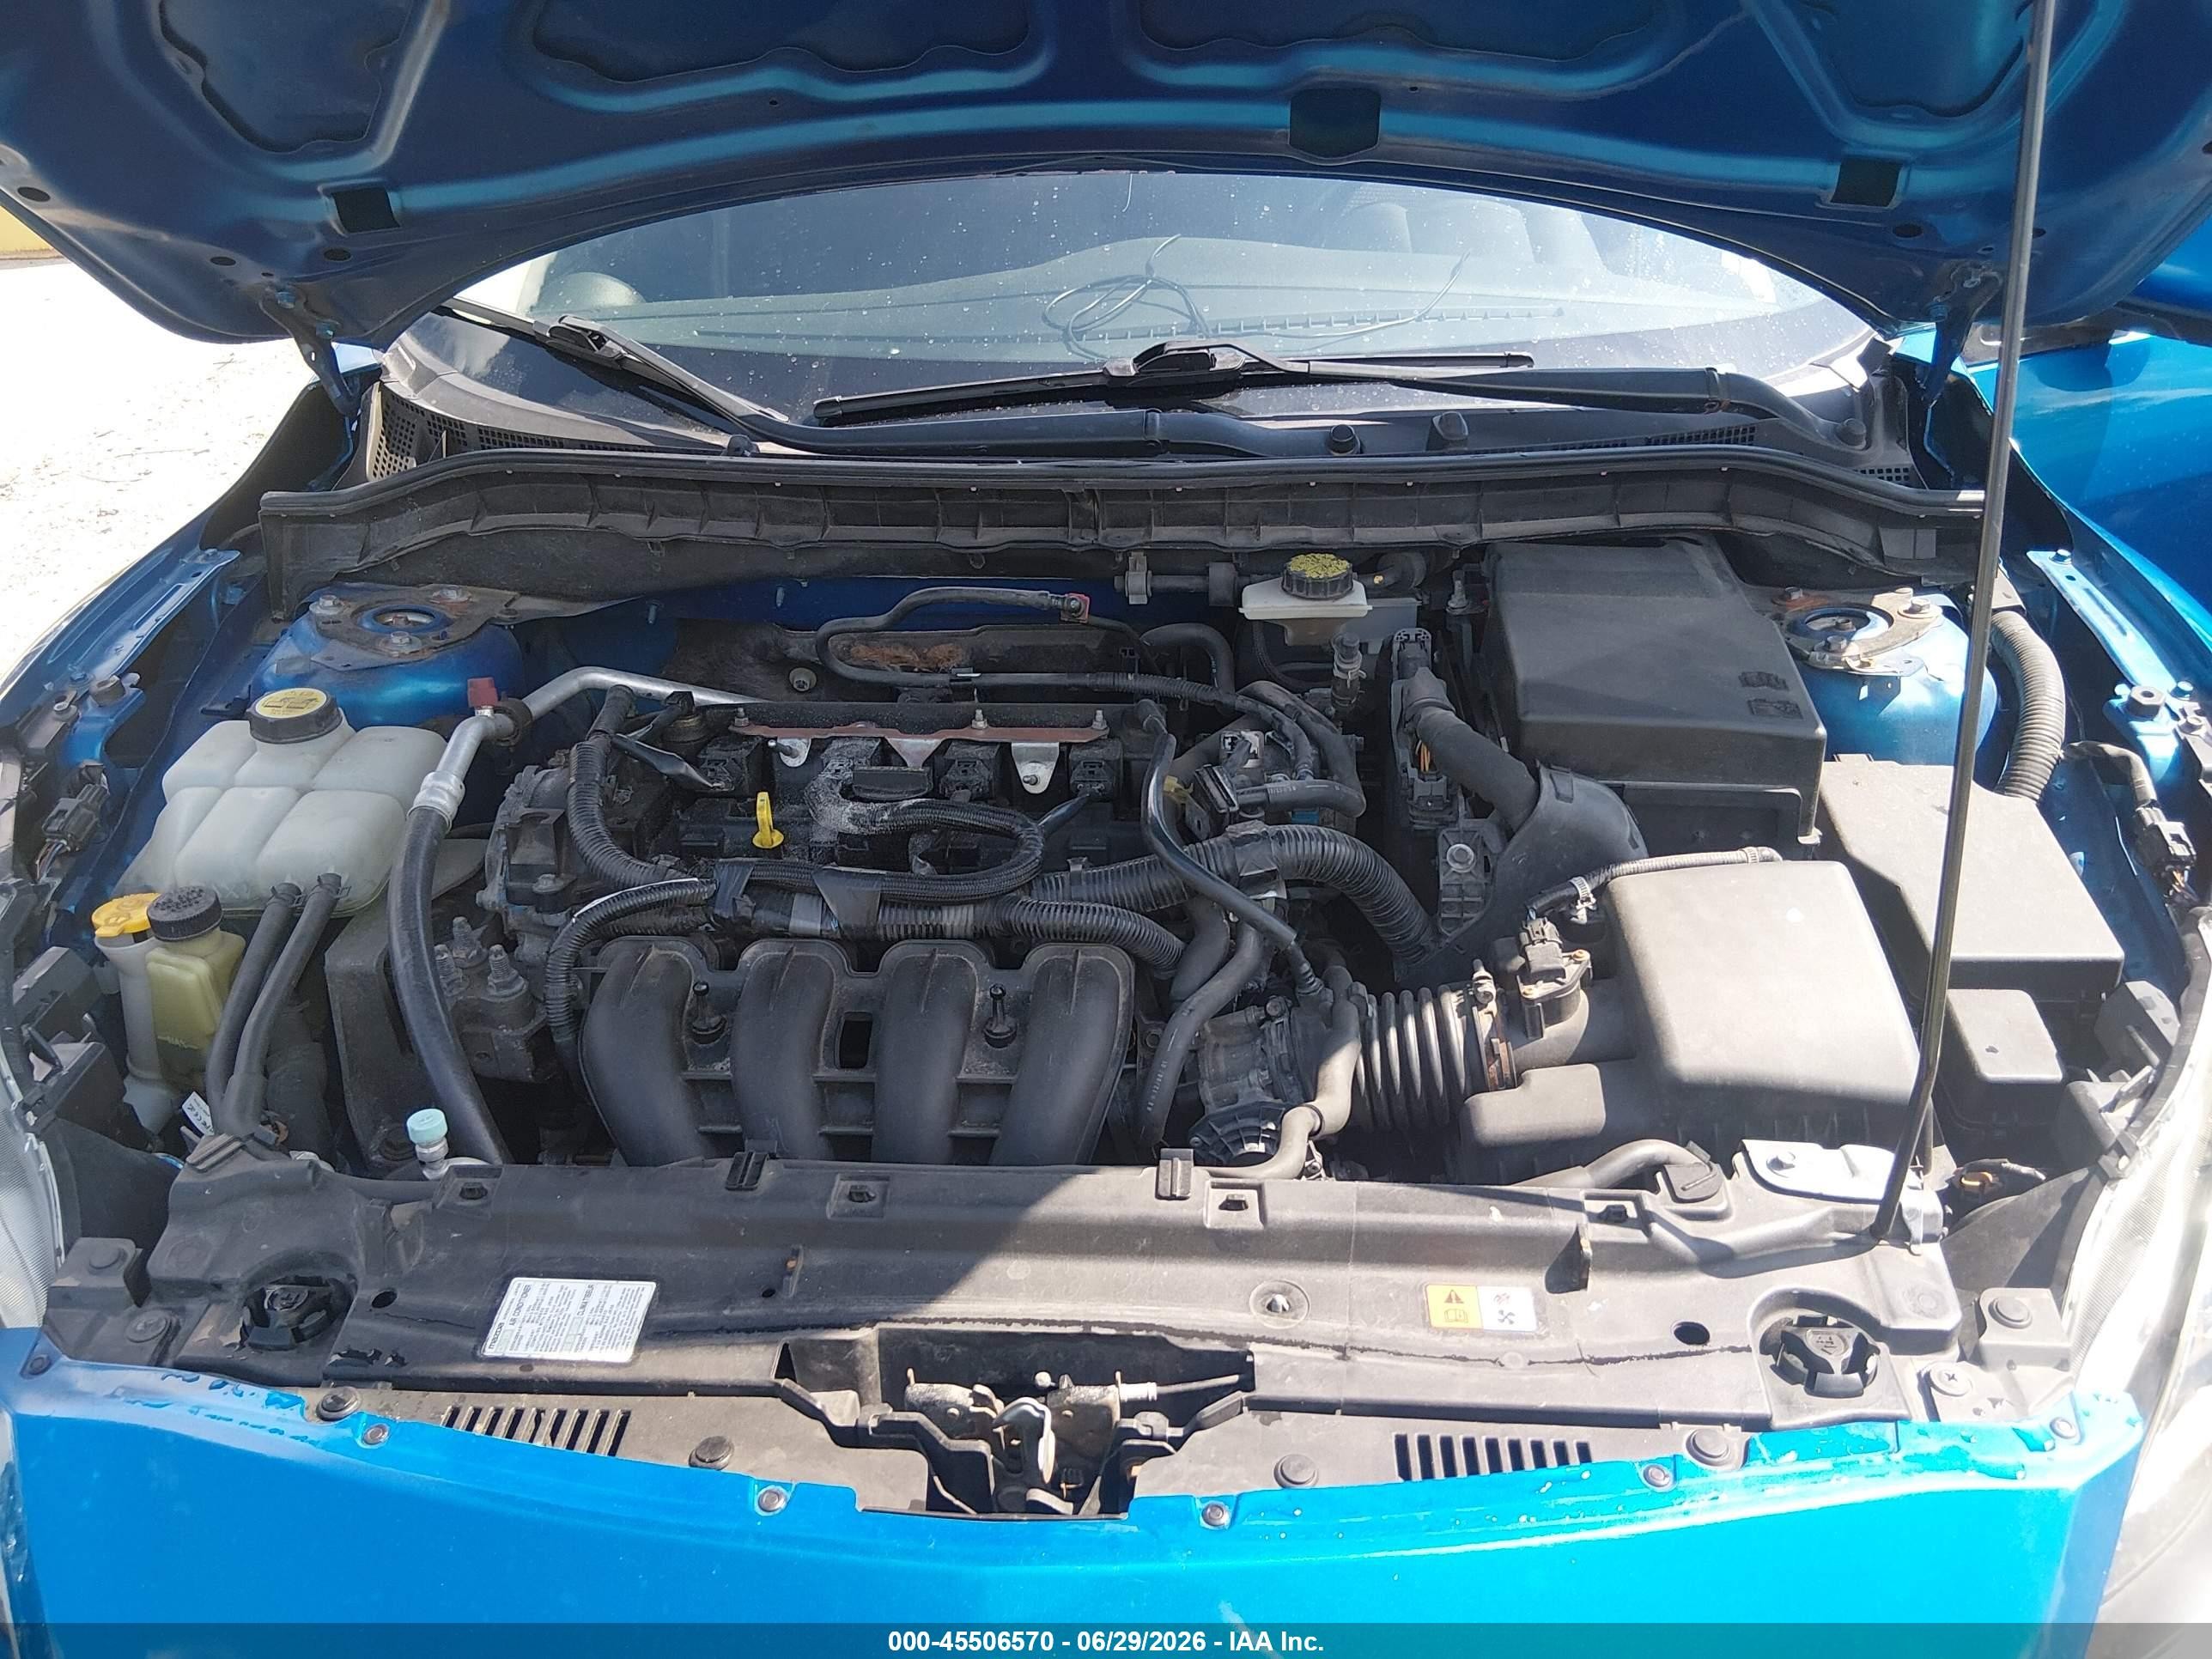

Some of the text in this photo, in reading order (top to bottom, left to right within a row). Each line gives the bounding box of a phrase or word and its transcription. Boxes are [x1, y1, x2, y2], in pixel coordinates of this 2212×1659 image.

[514, 1284, 532, 1317] CONDITIONER
[576, 1284, 595, 1316] CLIMATISEUR
[488, 1322, 504, 1349] mazda
